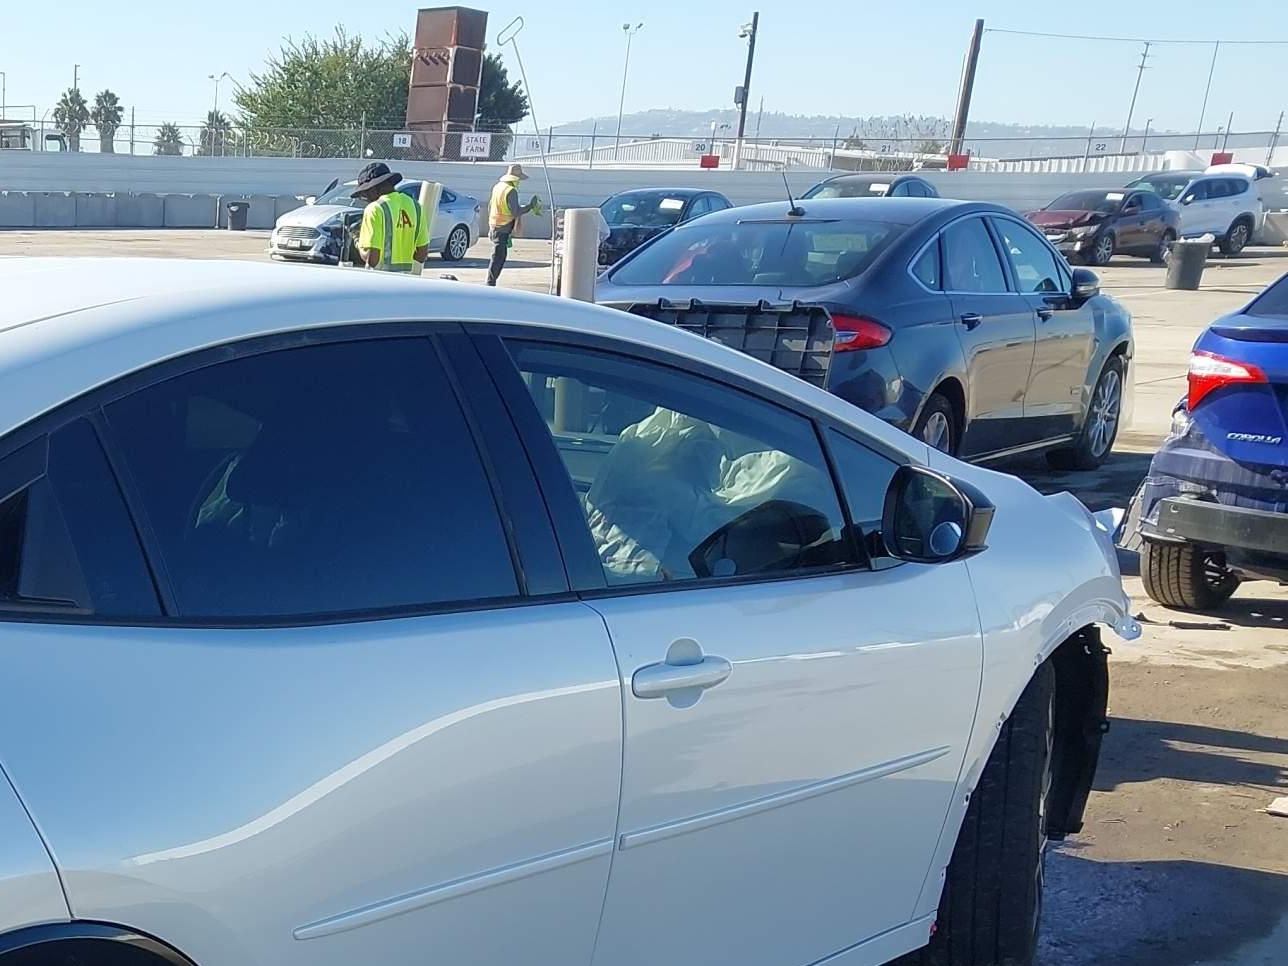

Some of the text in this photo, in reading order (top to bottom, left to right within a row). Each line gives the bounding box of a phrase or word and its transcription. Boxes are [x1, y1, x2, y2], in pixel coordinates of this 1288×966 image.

[398, 137, 407, 145] 18
[465, 136, 487, 144] STATE
[695, 143, 706, 151] 20
[881, 144, 891, 152] 21
[1095, 143, 1106, 151] 22
[1226, 432, 1282, 445] COROLLA
